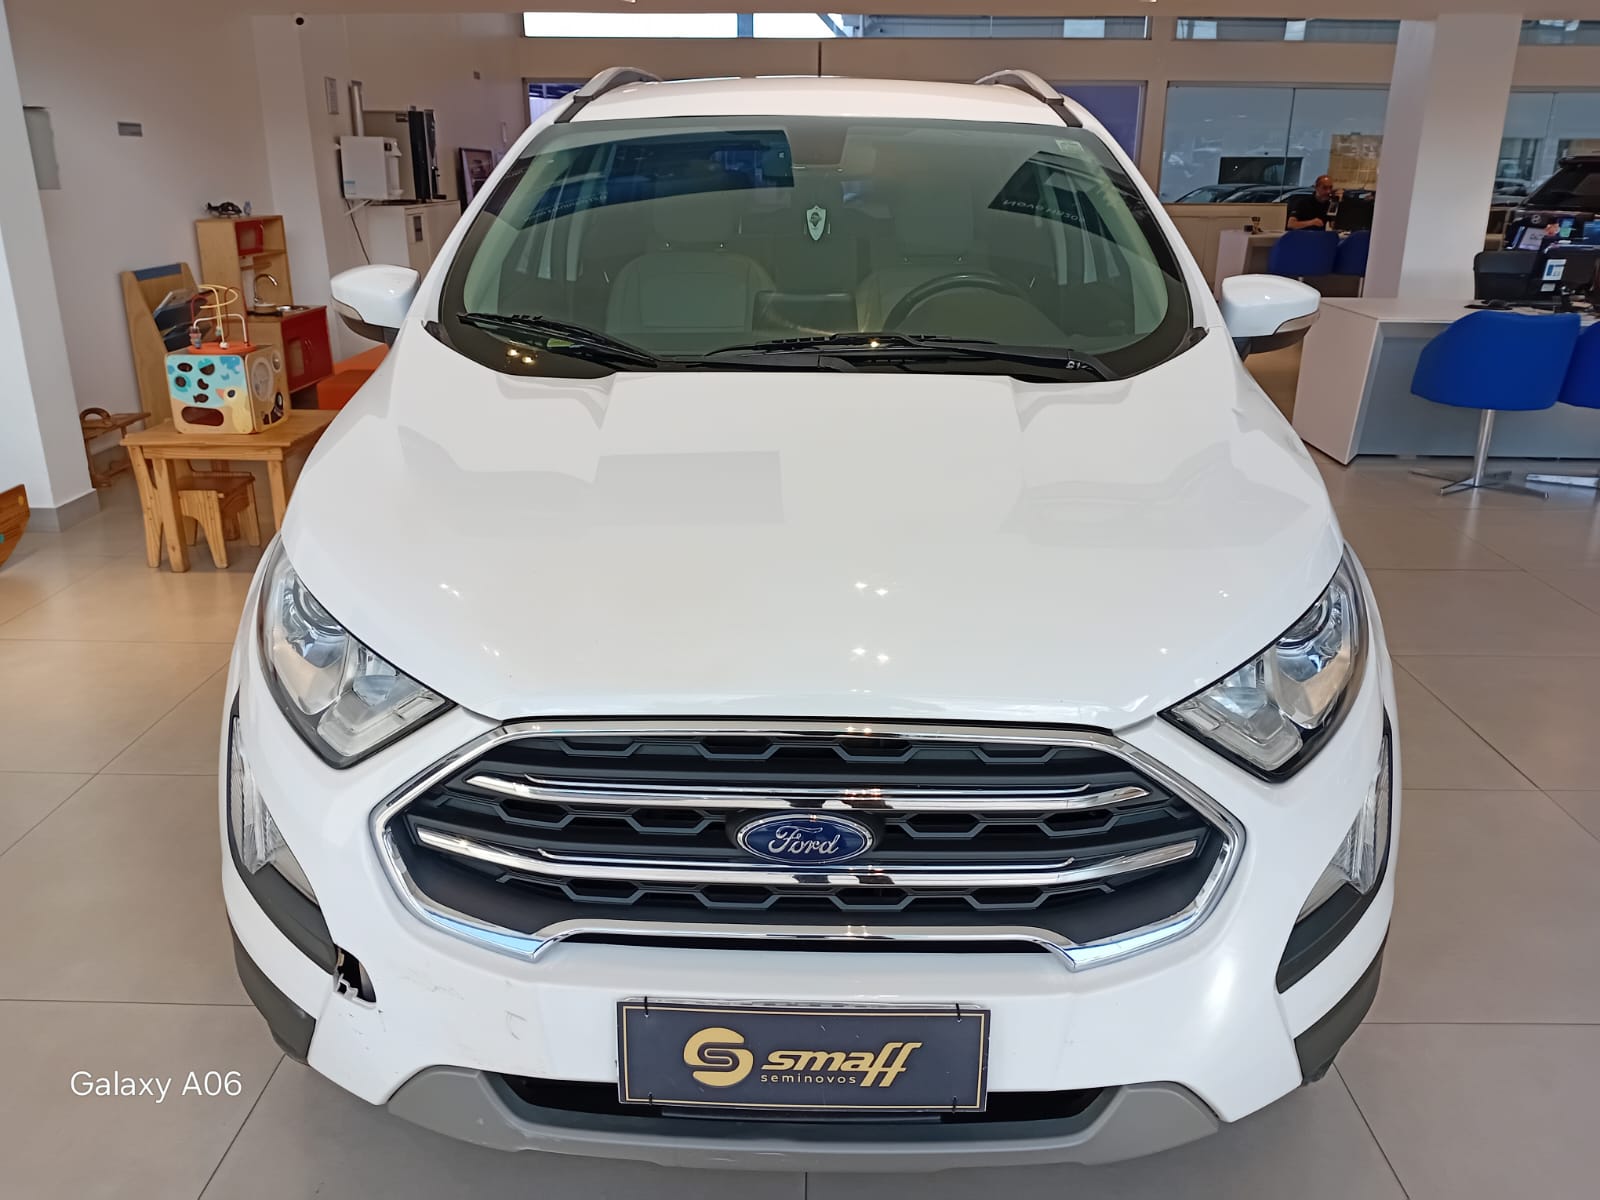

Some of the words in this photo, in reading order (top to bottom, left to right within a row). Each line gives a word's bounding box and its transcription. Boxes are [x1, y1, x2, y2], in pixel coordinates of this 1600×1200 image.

[768, 825, 841, 855] Ford
[760, 1073, 857, 1084] seminovos
[761, 1042, 922, 1087] smaff
